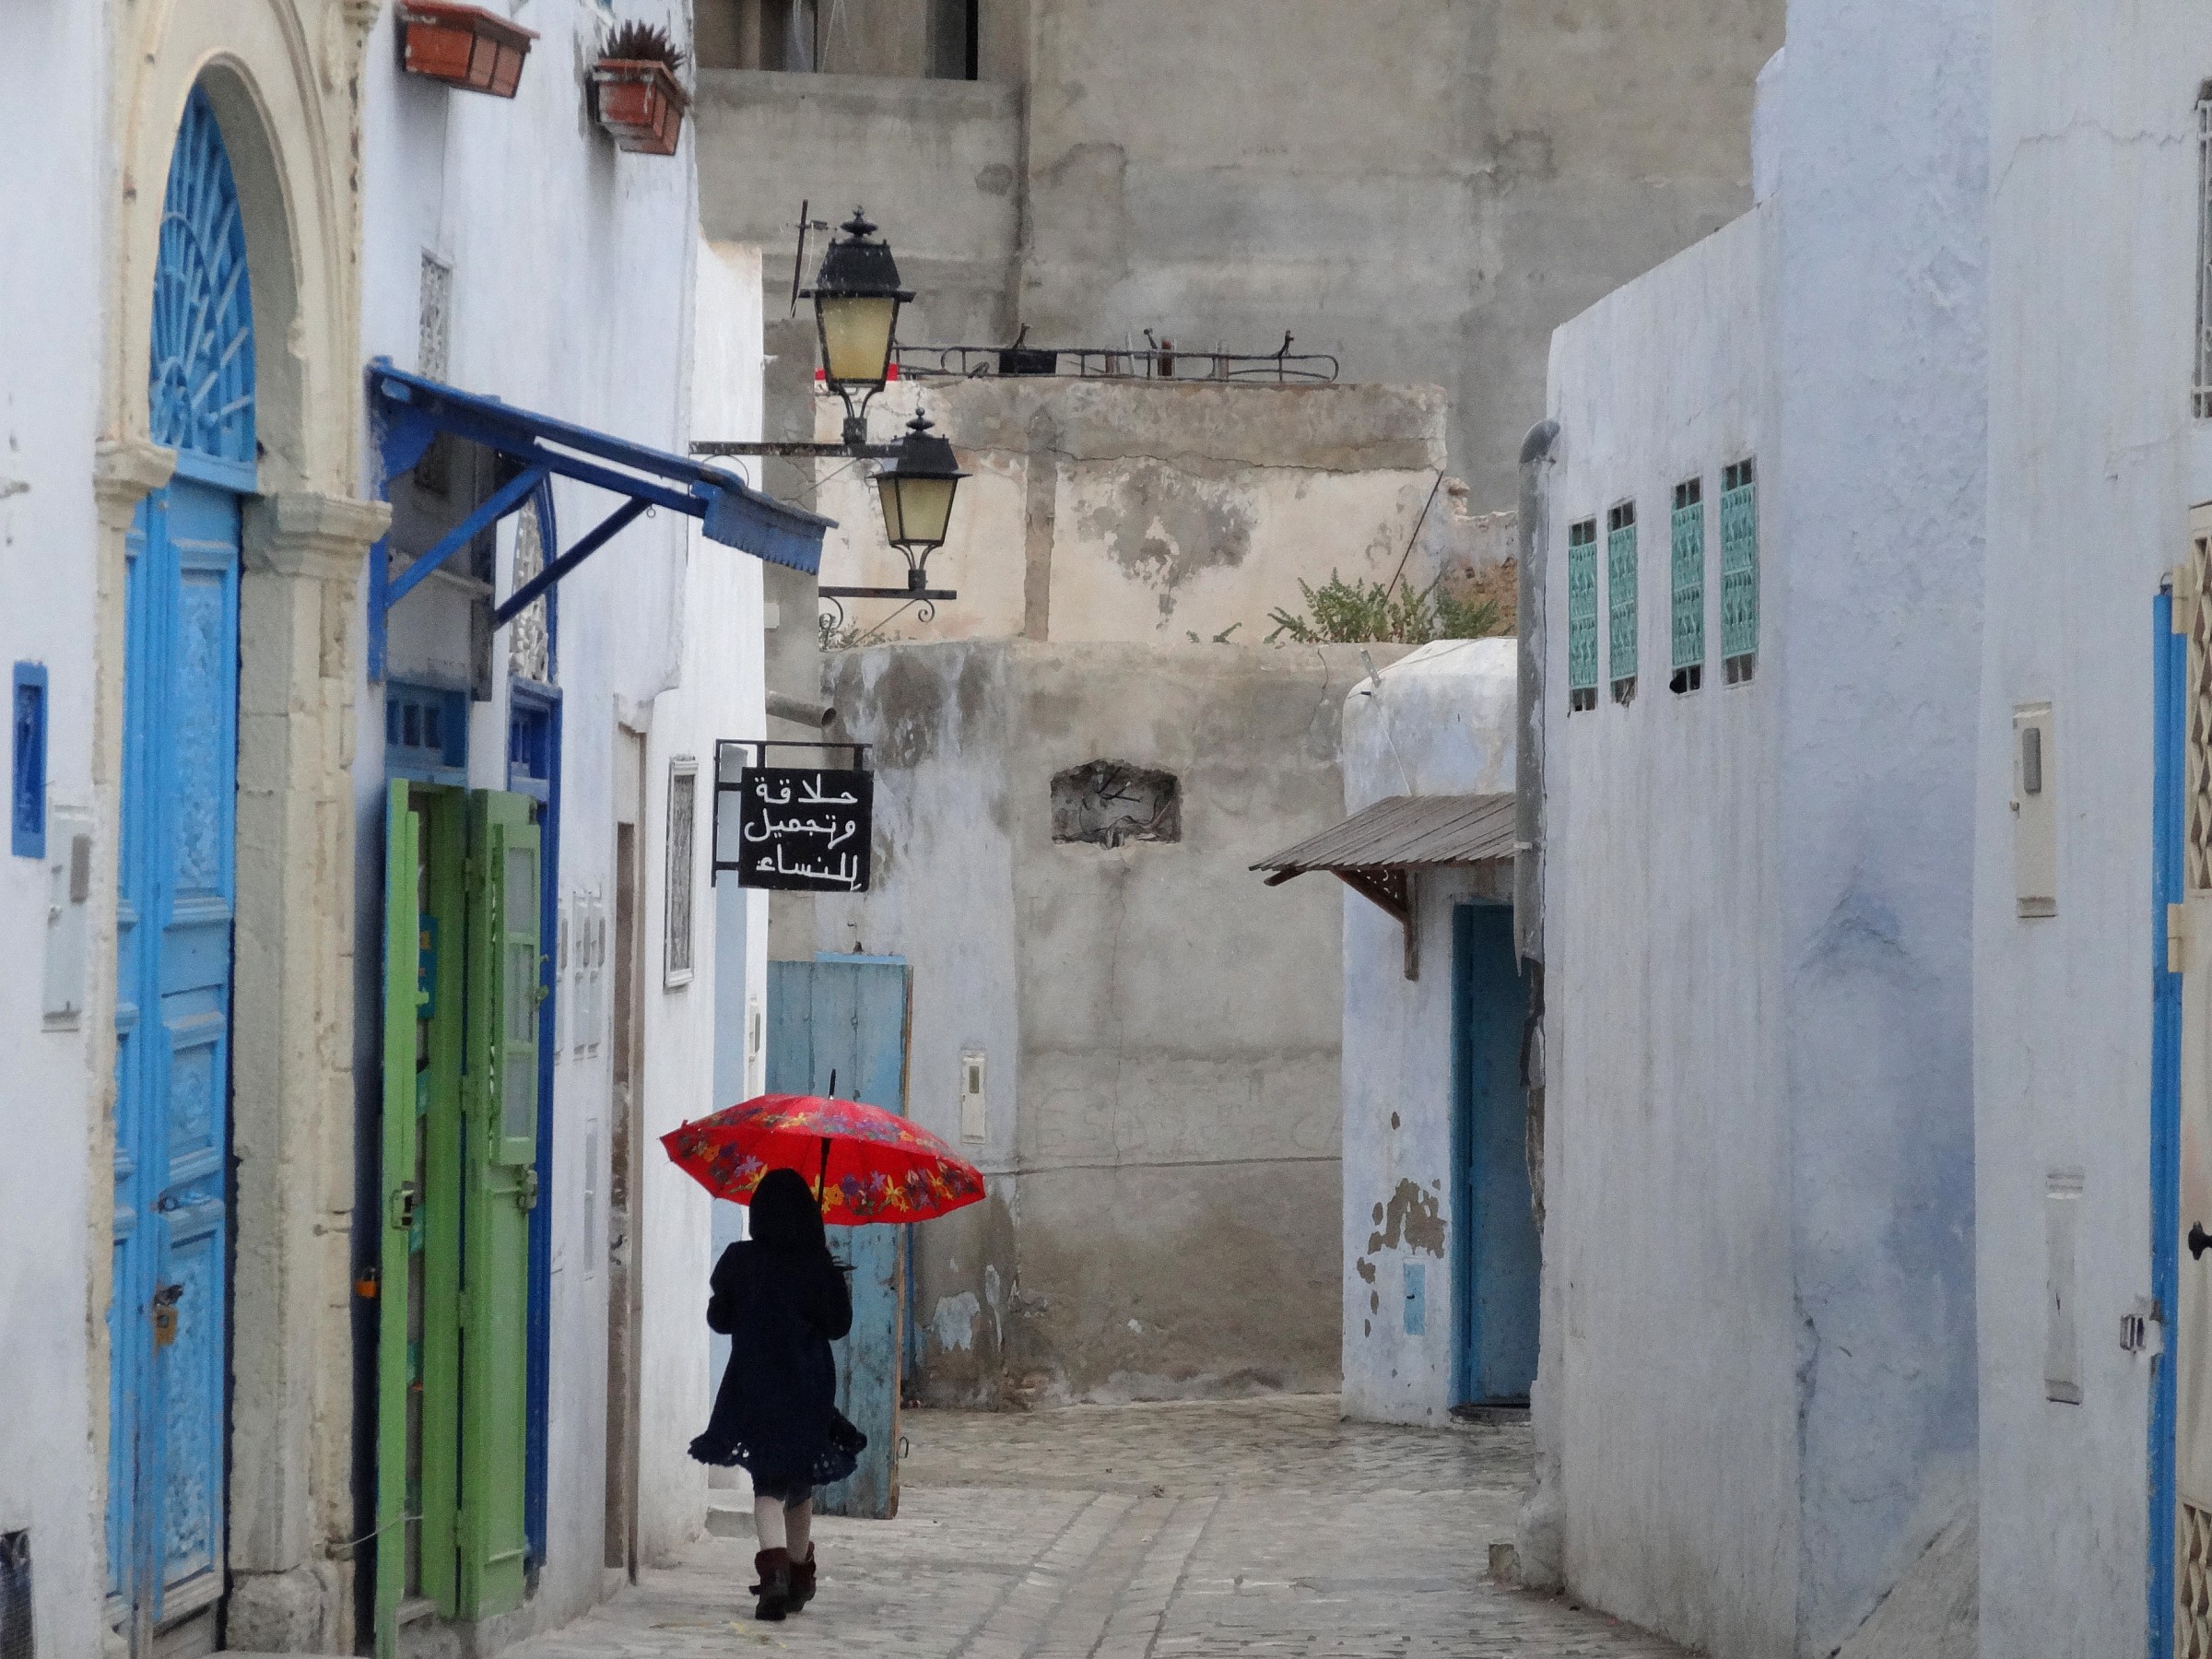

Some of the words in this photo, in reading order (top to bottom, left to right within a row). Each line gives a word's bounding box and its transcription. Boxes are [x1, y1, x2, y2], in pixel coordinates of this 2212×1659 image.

[754, 772, 858, 805] حلاقة
[744, 807, 856, 850] وتجميل
[756, 843, 863, 891] للنساء
